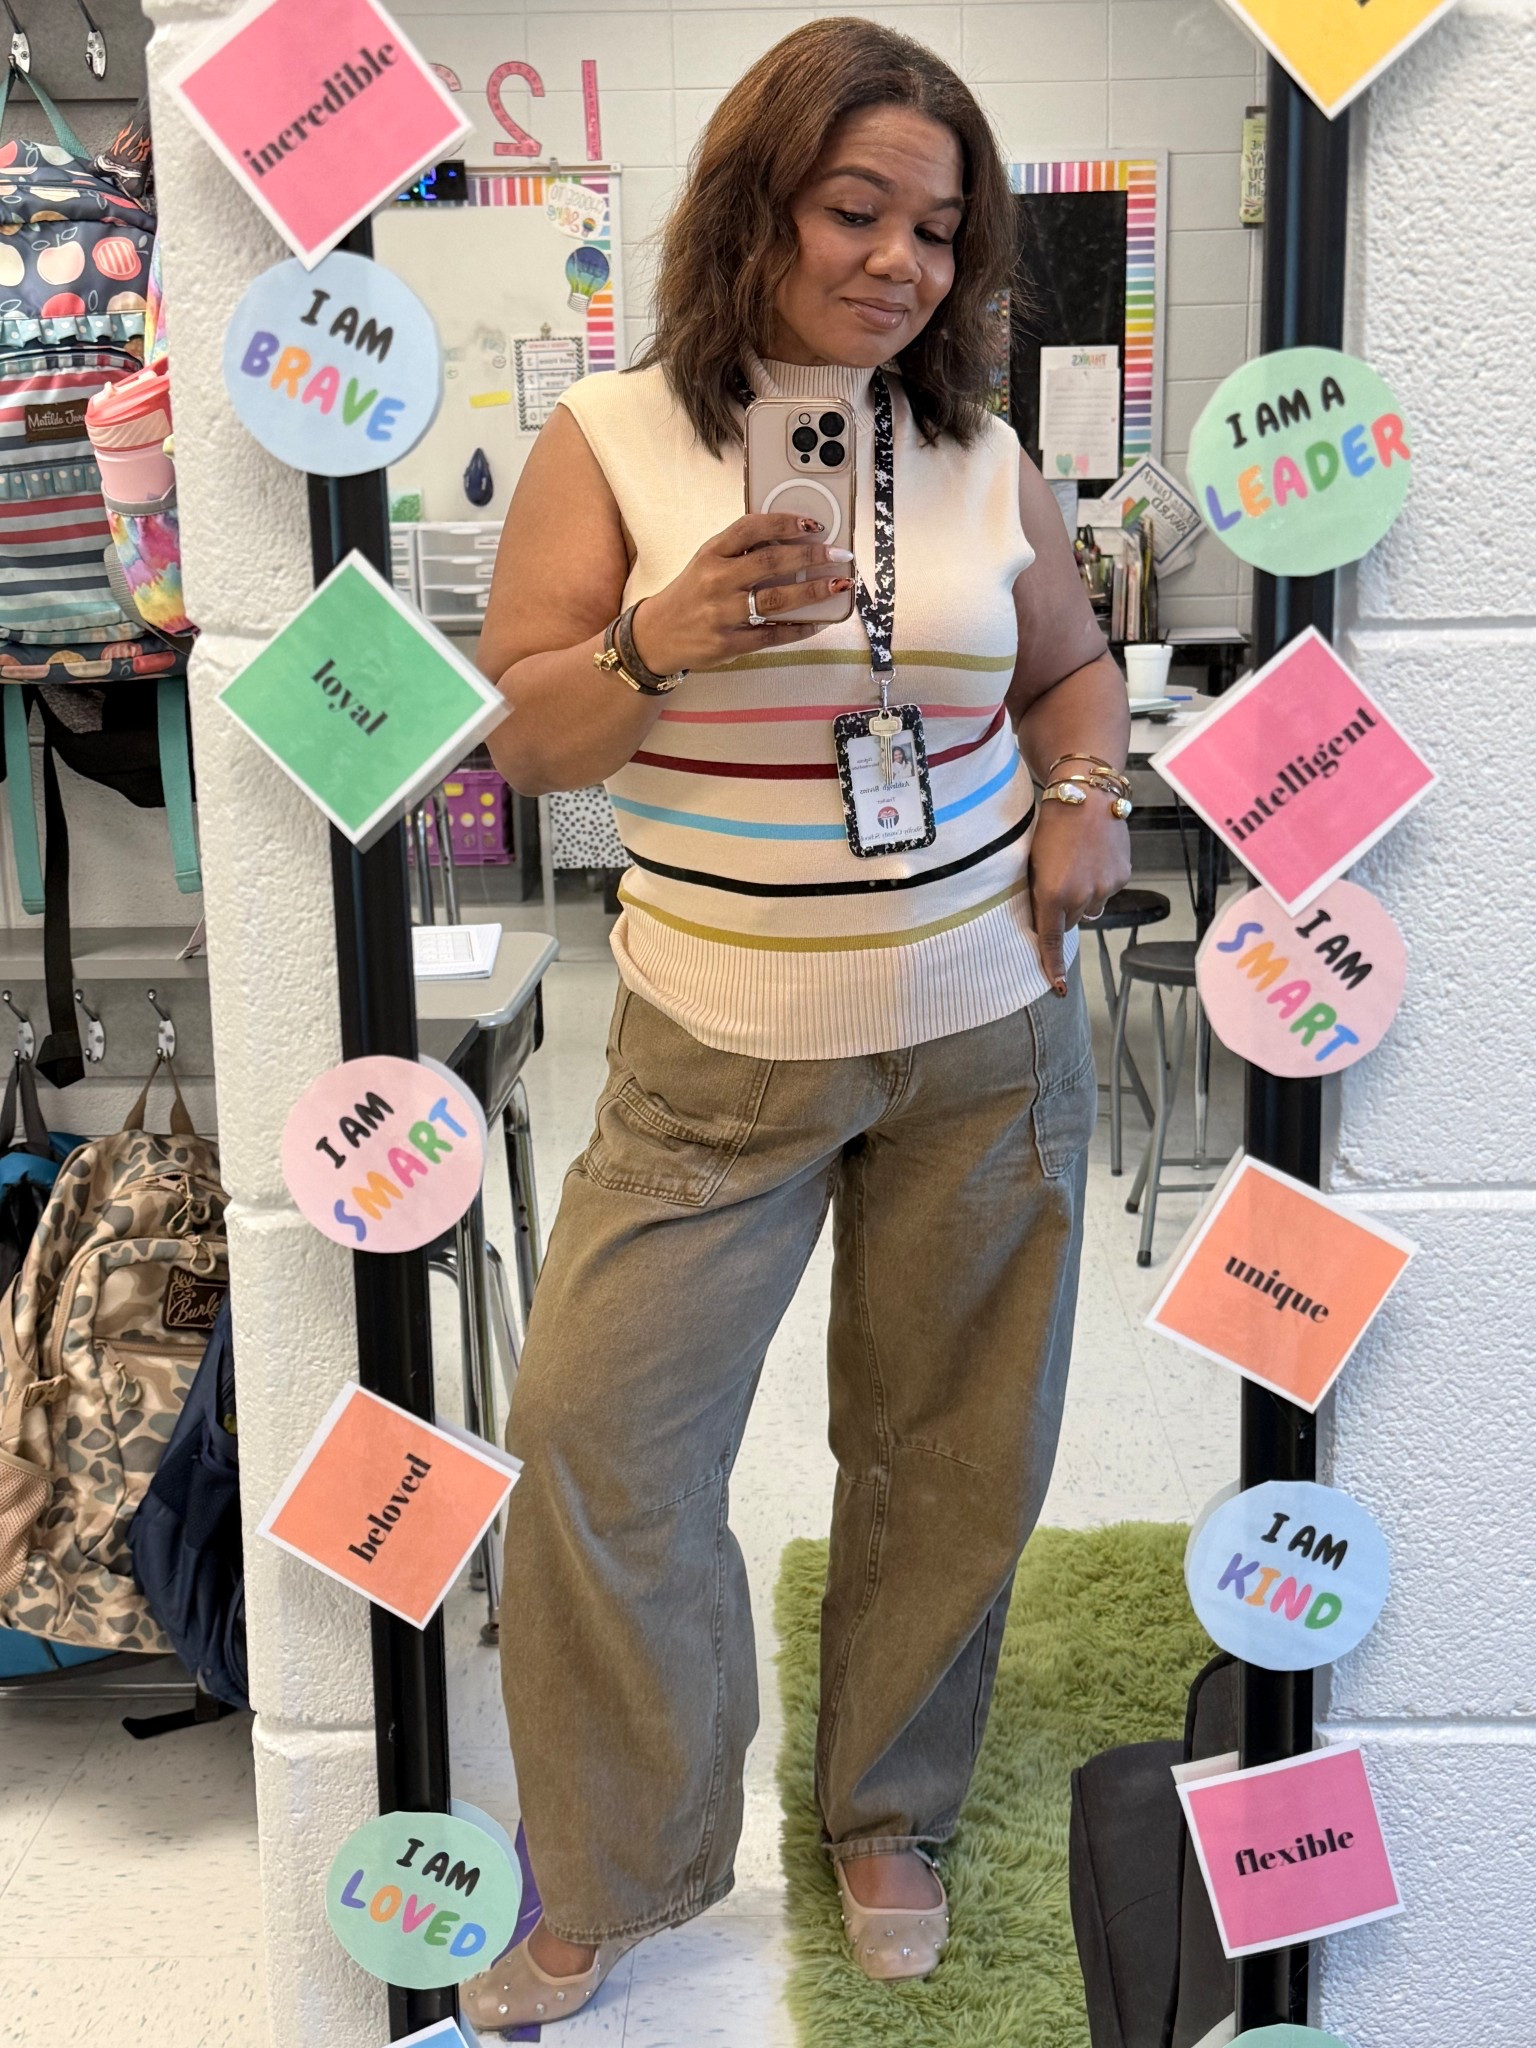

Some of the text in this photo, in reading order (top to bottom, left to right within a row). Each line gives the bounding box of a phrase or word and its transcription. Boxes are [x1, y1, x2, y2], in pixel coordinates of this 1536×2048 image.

[243, 38, 397, 178] incredible
[301, 290, 394, 364] I AM
[28, 410, 85, 429] Matilda Jan
[241, 331, 406, 441] BRAVE
[1225, 376, 1346, 449] I AM A
[1205, 413, 1411, 532] LEADER
[310, 658, 390, 738] loyal
[1225, 706, 1378, 843] intelligent
[1295, 909, 1372, 991] I AM
[1216, 922, 1359, 1061] SMART
[315, 1091, 395, 1169] I AM
[334, 1098, 468, 1242] SMART
[169, 1292, 220, 1324] Burle
[1224, 1255, 1329, 1324] unique
[347, 1453, 432, 1565] beloved
[1261, 1512, 1348, 1571] I AM
[1217, 1552, 1343, 1630] KIND
[396, 1838, 481, 1897] I AM
[1235, 1828, 1355, 1876] flexible
[340, 1869, 486, 1957] LOVED
